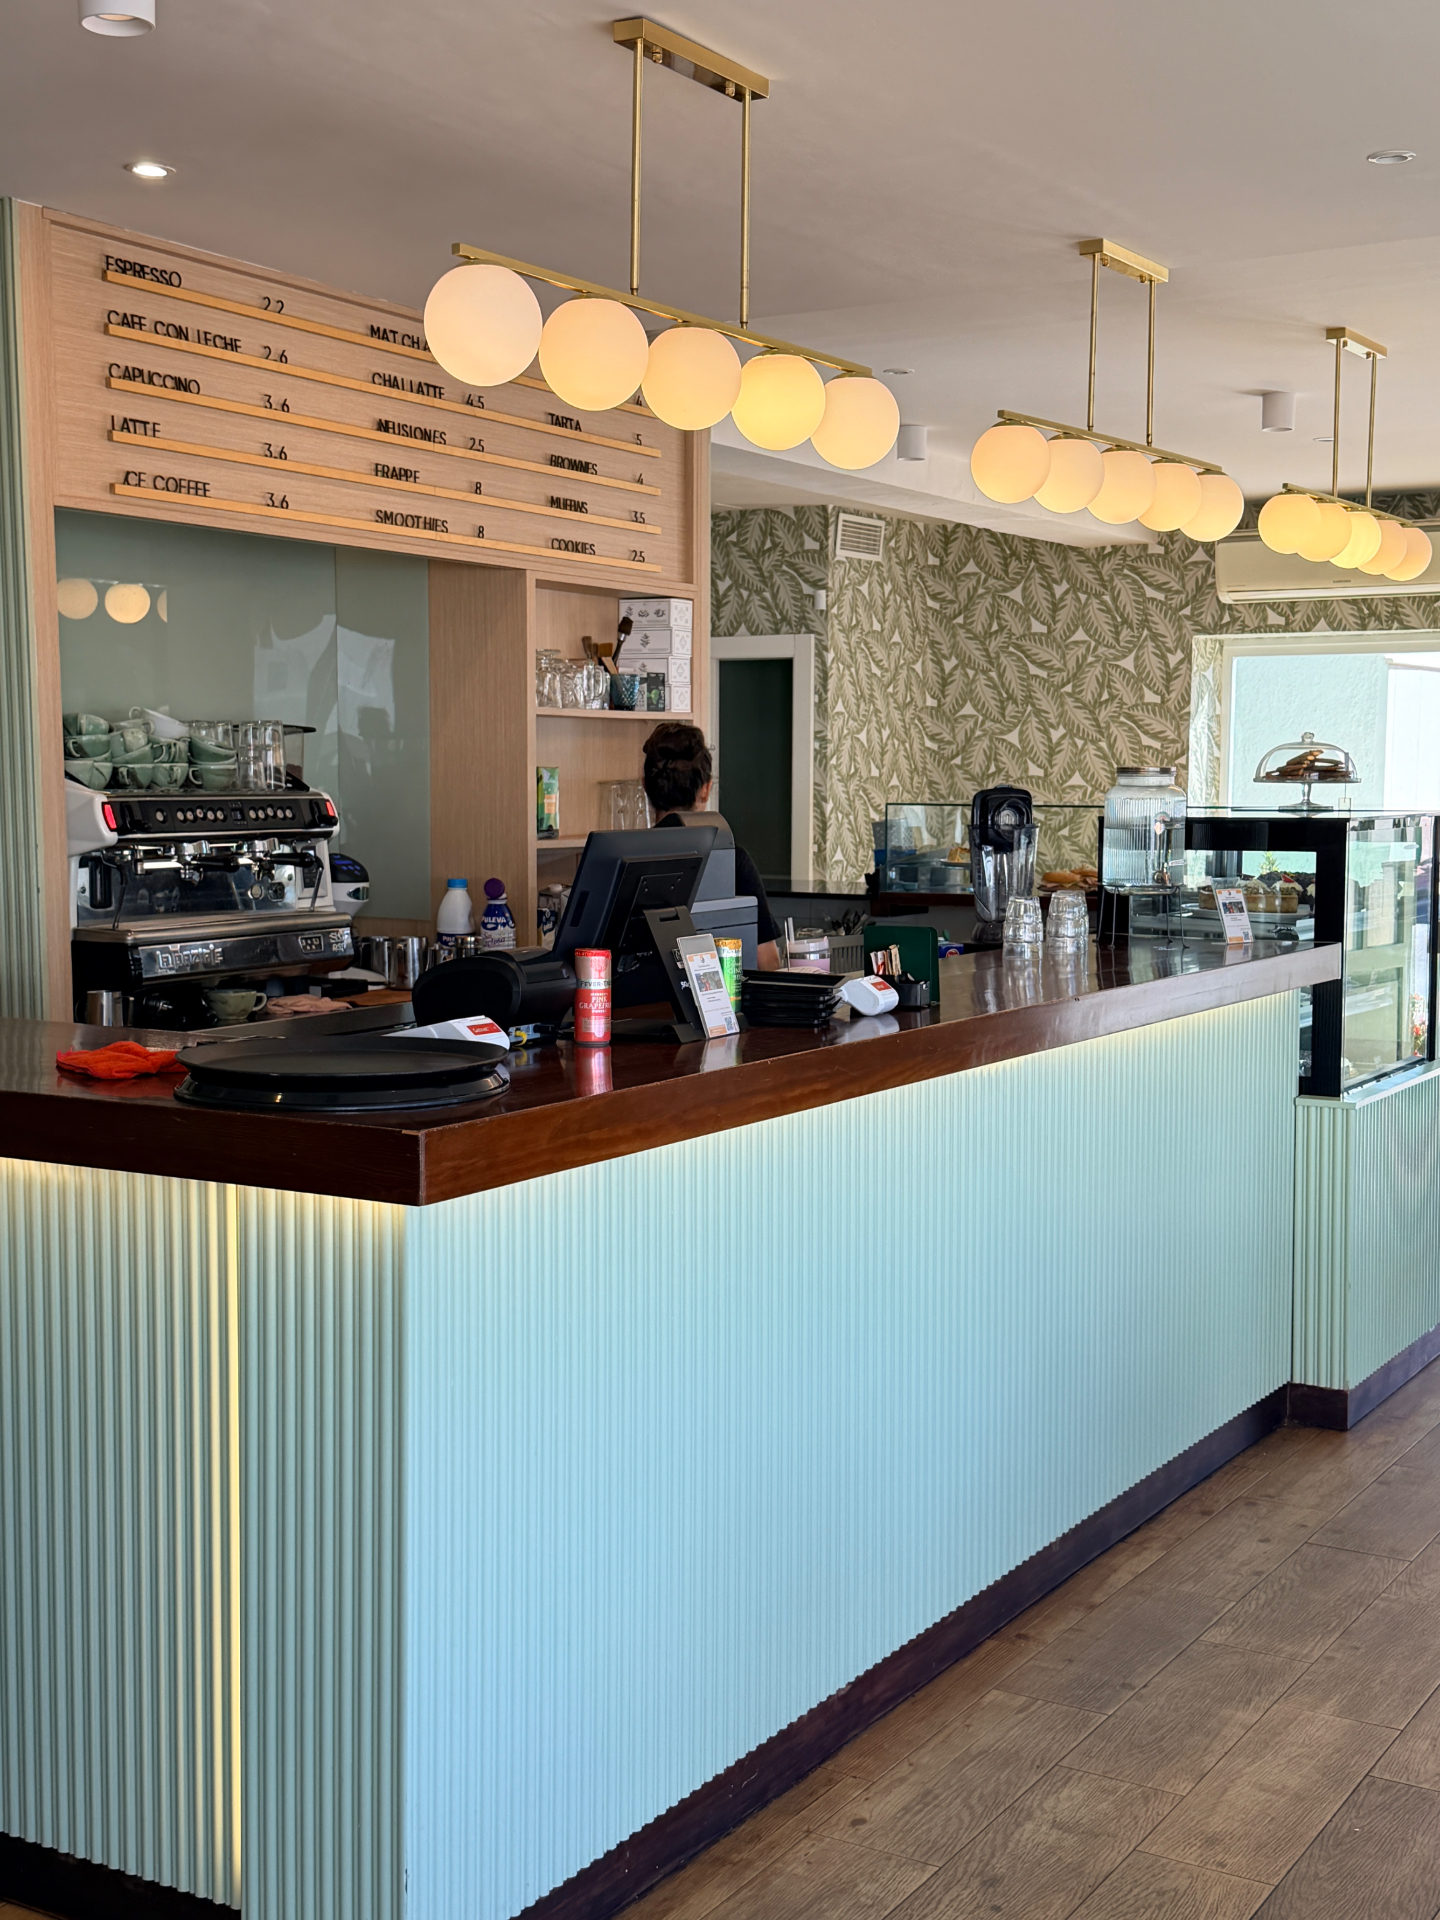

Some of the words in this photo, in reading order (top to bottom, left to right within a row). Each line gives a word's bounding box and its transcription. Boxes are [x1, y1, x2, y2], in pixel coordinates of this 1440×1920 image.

[104, 255, 182, 288] ESPRESSO
[154, 321, 189, 341] CON
[109, 363, 200, 395] CAPUCCINO
[111, 415, 161, 438] LATTE
[548, 413, 582, 432] TARTA
[636, 433, 642, 446] 5
[153, 475, 211, 498] COFFEE
[375, 462, 421, 483] FRAPPE
[474, 481, 482, 496] 8
[637, 473, 643, 485] 4
[375, 509, 449, 534] SMOOTHIES
[477, 525, 485, 539] 8
[551, 538, 596, 556] COOKIES
